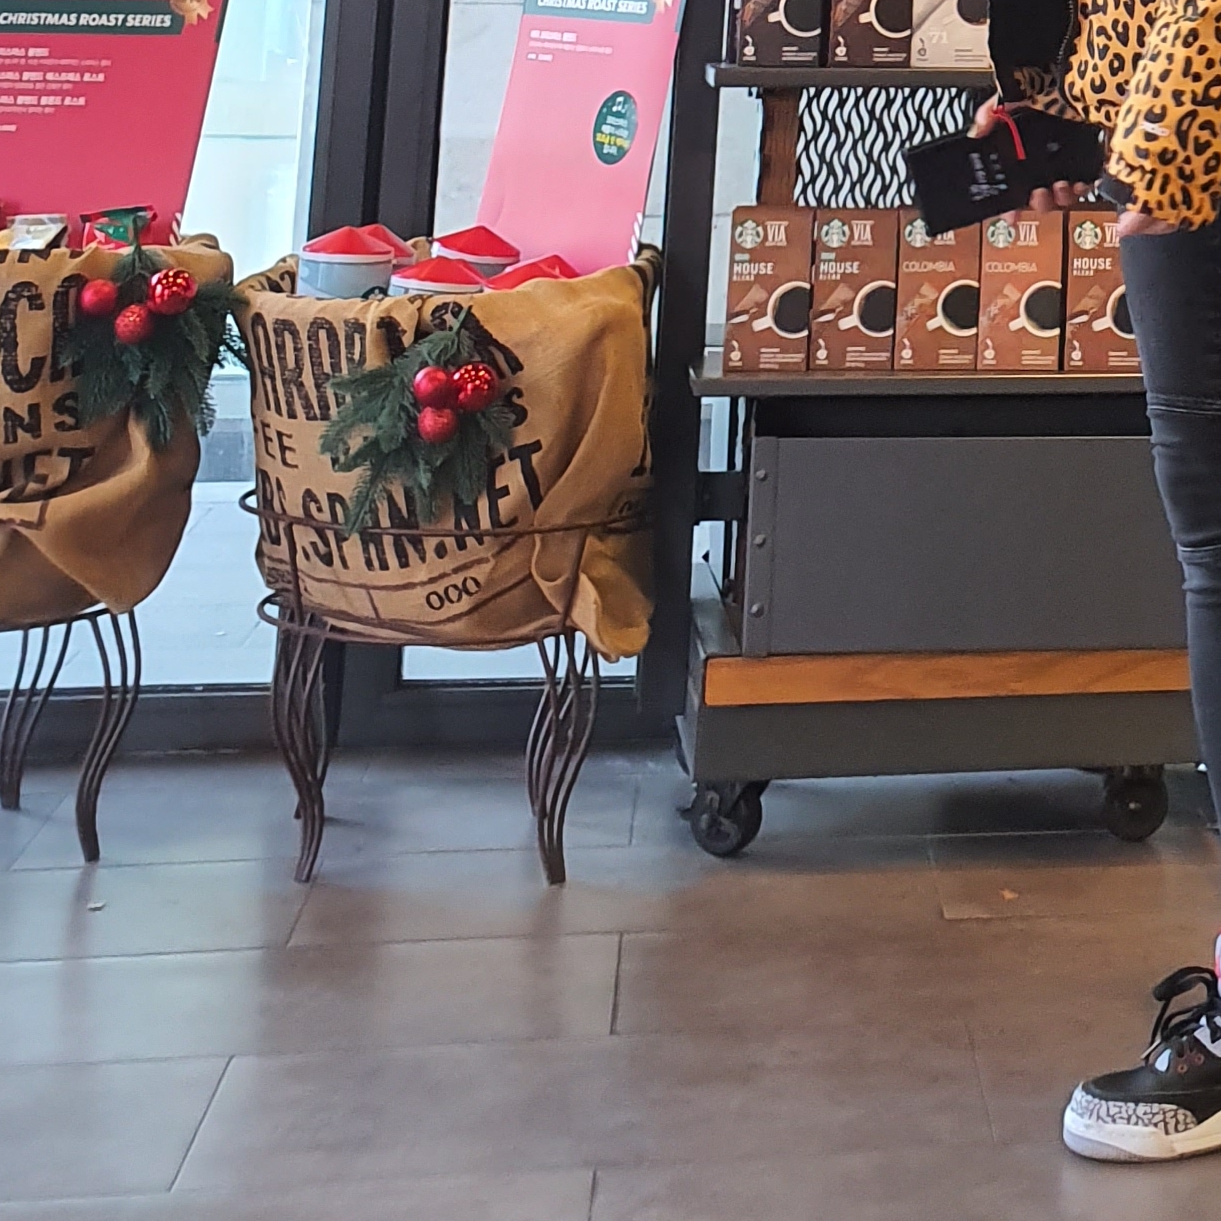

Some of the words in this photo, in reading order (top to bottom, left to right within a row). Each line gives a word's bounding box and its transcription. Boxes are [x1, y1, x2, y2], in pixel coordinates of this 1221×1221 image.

[616, 0, 648, 14] SERIES
[0, 11, 77, 26] CHRISTMAS
[79, 13, 126, 27] ROAST
[126, 14, 172, 28] SERIES
[929, 31, 949, 44] 71
[767, 223, 787, 243] VIA
[852, 222, 873, 243] VIA
[1018, 223, 1038, 242] VIA
[733, 262, 774, 275] HOUSE
[818, 261, 861, 274] HOUSE
[902, 260, 956, 273] COLOMBIA
[985, 261, 1038, 273] COLOMBIA
[1073, 257, 1113, 270] HOUSE
